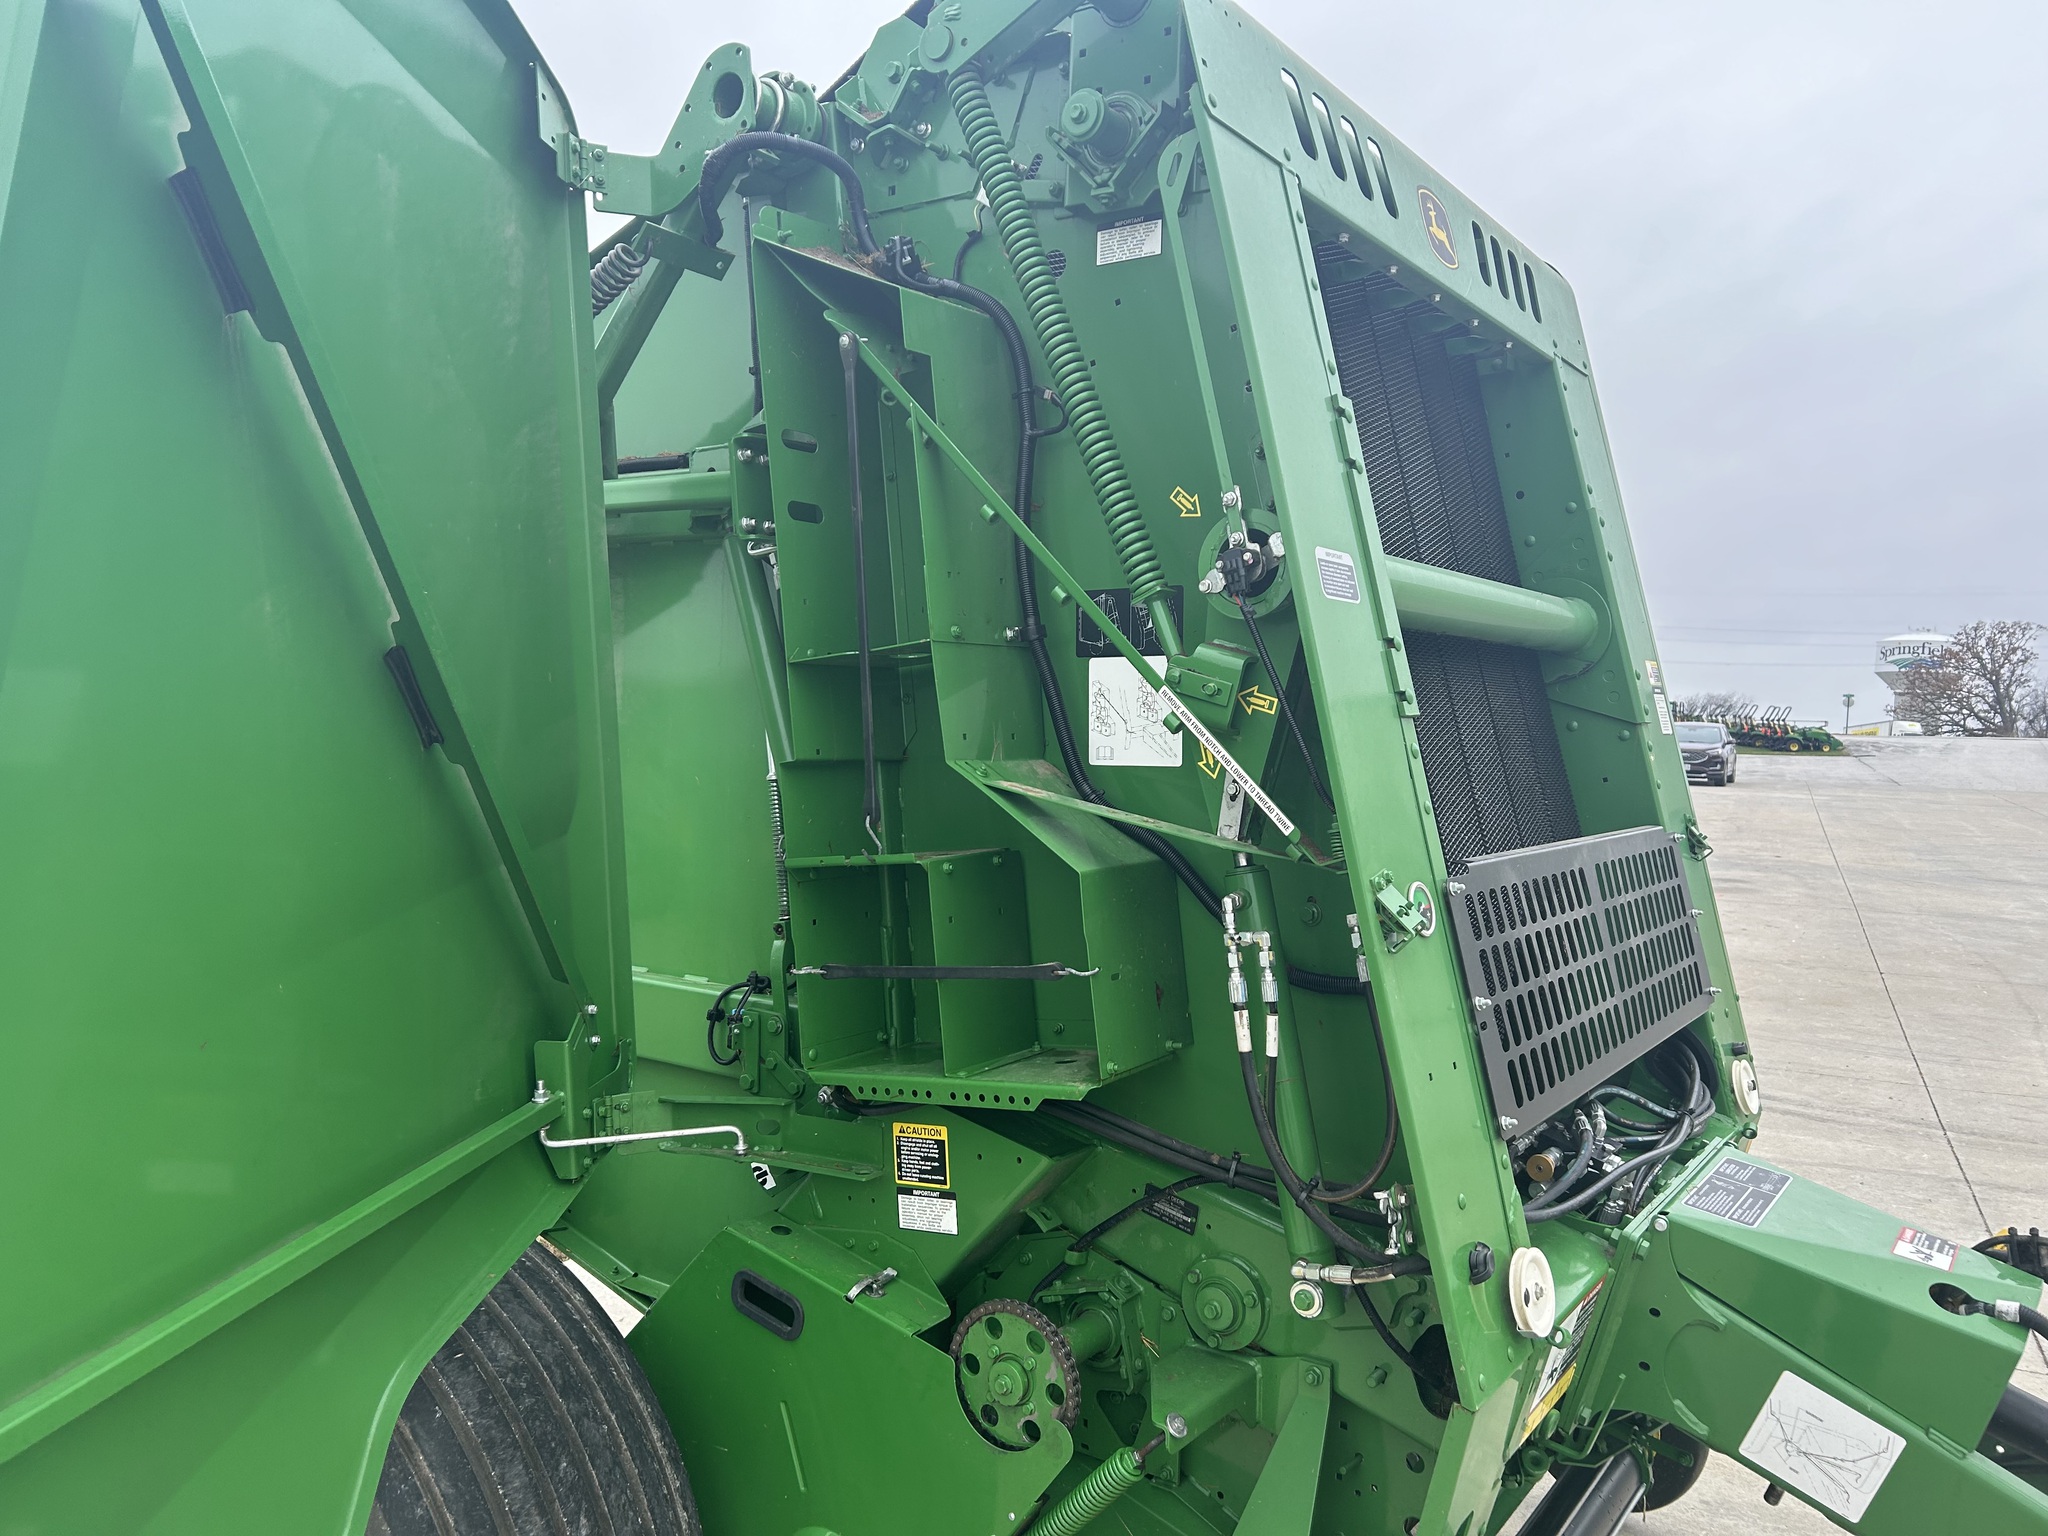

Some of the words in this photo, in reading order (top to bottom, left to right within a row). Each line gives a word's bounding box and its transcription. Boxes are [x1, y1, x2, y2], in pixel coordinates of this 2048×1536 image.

[1114, 216, 1145, 227] IMPORTANT
[1880, 642, 1946, 661] Springfiel
[1161, 689, 1182, 712] REMOVE
[1180, 710, 1193, 723] ARM
[1190, 721, 1206, 739] FROM
[1204, 736, 1222, 756] NOTCH
[1220, 754, 1232, 767] AND
[1230, 765, 1249, 786] LOWER
[1247, 784, 1256, 794] TO
[1255, 790, 1275, 815] THREAD
[1274, 811, 1292, 832] TWINE
[905, 1126, 942, 1137] CAUTION
[912, 1189, 940, 1197] IMPORTANT
